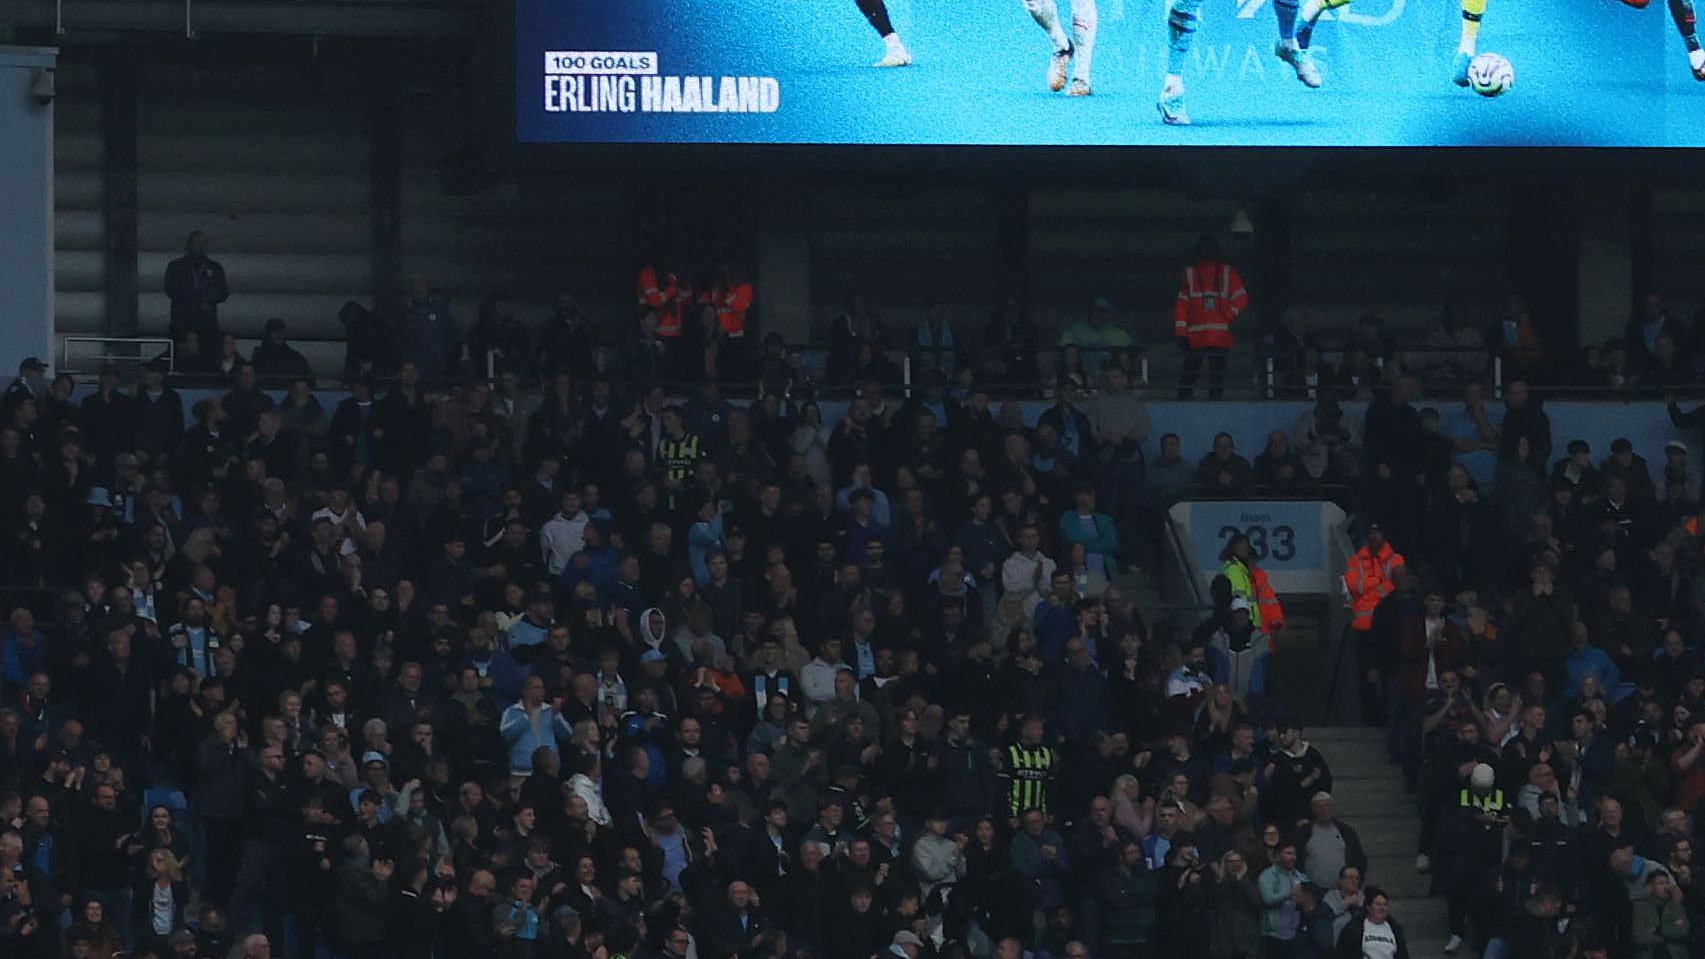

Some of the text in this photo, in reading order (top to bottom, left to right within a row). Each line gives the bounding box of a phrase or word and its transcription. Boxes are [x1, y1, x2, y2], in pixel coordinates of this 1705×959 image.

[553, 57, 650, 69] 100 GOALS
[545, 75, 780, 113] ERLING HAALAND
